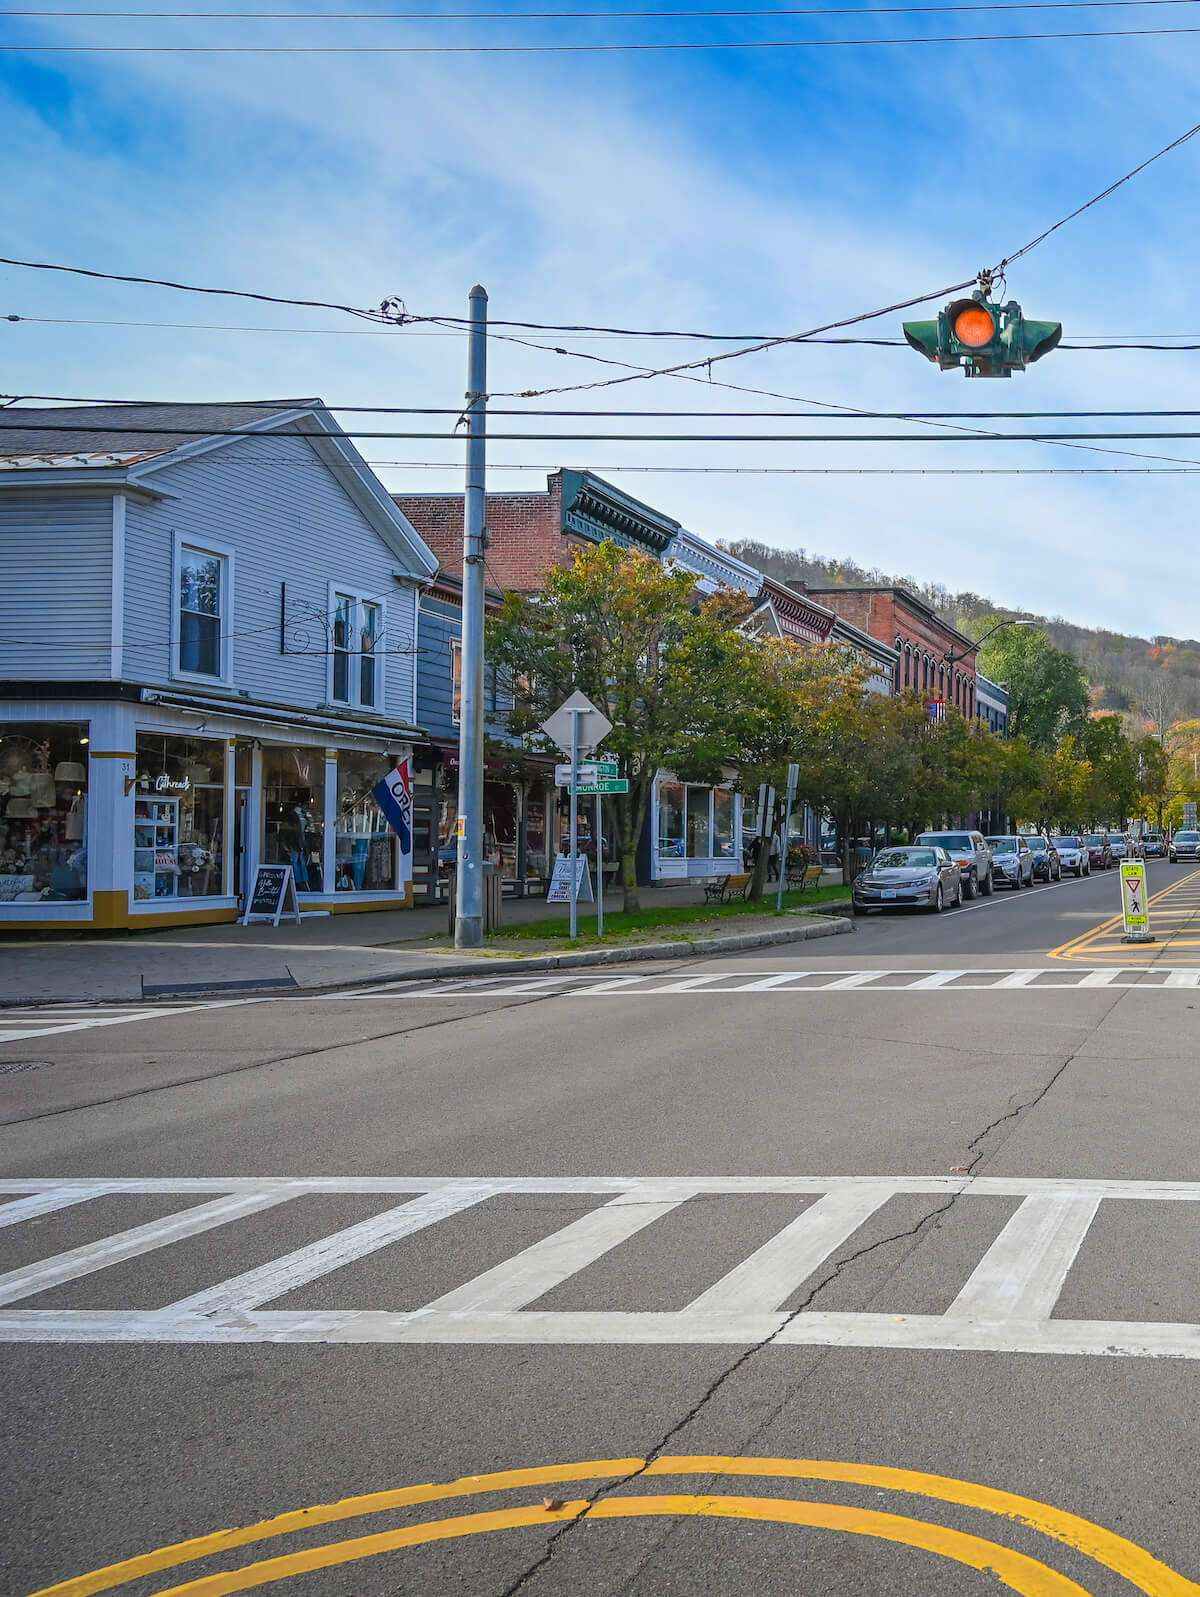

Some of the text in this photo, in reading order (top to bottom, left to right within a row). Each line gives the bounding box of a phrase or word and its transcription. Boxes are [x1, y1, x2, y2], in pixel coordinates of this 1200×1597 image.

[122, 763, 129, 771] 31
[576, 782, 609, 791] MONROE
[392, 782, 411, 825] OPE
